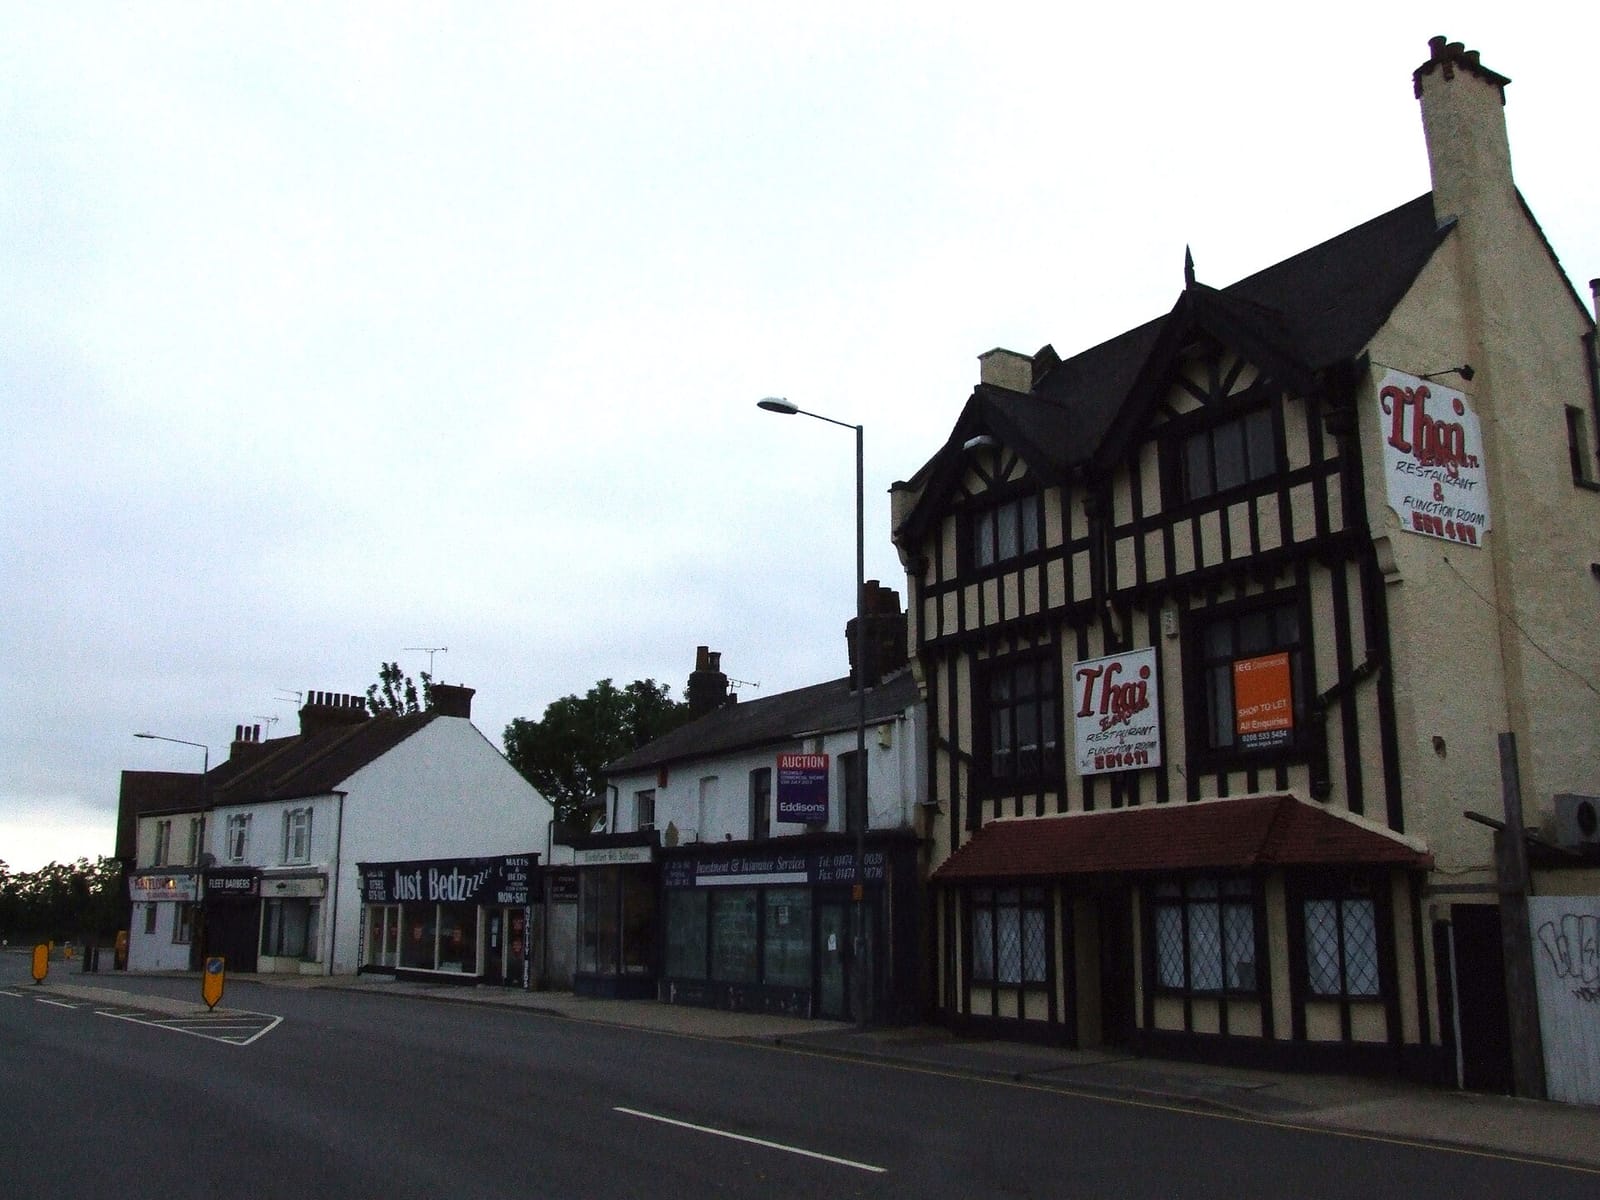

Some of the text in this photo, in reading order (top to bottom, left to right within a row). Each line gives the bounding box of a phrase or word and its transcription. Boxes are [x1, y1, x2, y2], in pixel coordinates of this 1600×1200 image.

[1380, 385, 1465, 459] Thai
[1395, 461, 1477, 491] RESTAURANT
[1433, 483, 1444, 502] &
[1403, 496, 1485, 526] FUNCTION ROOM
[1076, 662, 1150, 717] Thai
[1238, 699, 1287, 717] SHOP TO LET
[1240, 717, 1288, 731] All Enquiries
[1086, 726, 1157, 742] RESTAURANT
[1087, 741, 1157, 758] FUNCTION ROOM
[782, 756, 824, 768] AUCTION
[780, 802, 825, 812] Eddisons
[731, 859, 739, 872] &
[777, 856, 805, 870] Services
[208, 878, 250, 889] FLEET BARBERS
[393, 868, 422, 900] Just
